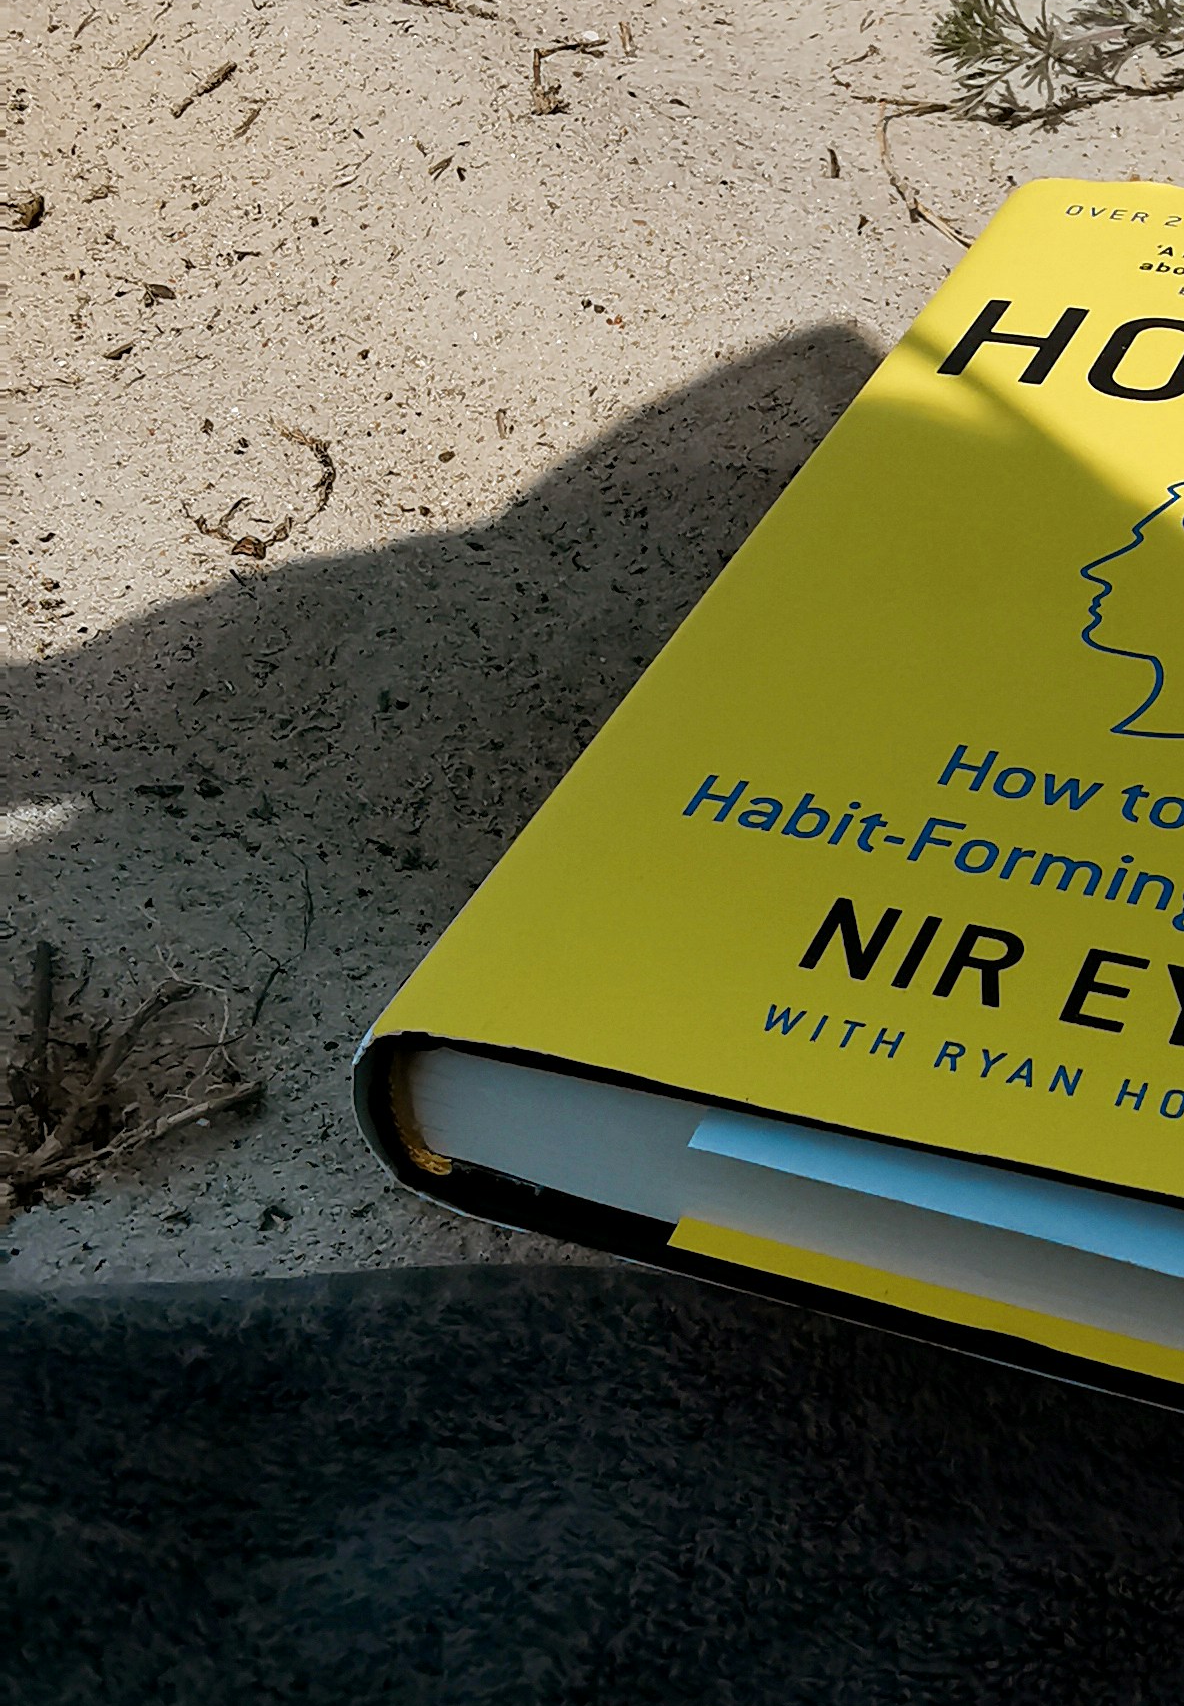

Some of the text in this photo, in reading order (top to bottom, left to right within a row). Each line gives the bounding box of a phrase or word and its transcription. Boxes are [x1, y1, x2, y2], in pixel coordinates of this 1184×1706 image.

[1065, 204, 1150, 224] OVER
[937, 744, 1105, 813] How
[797, 895, 1026, 1009] NIR
[762, 1003, 906, 1061] WITH
[934, 1040, 1085, 1098] RYAN
